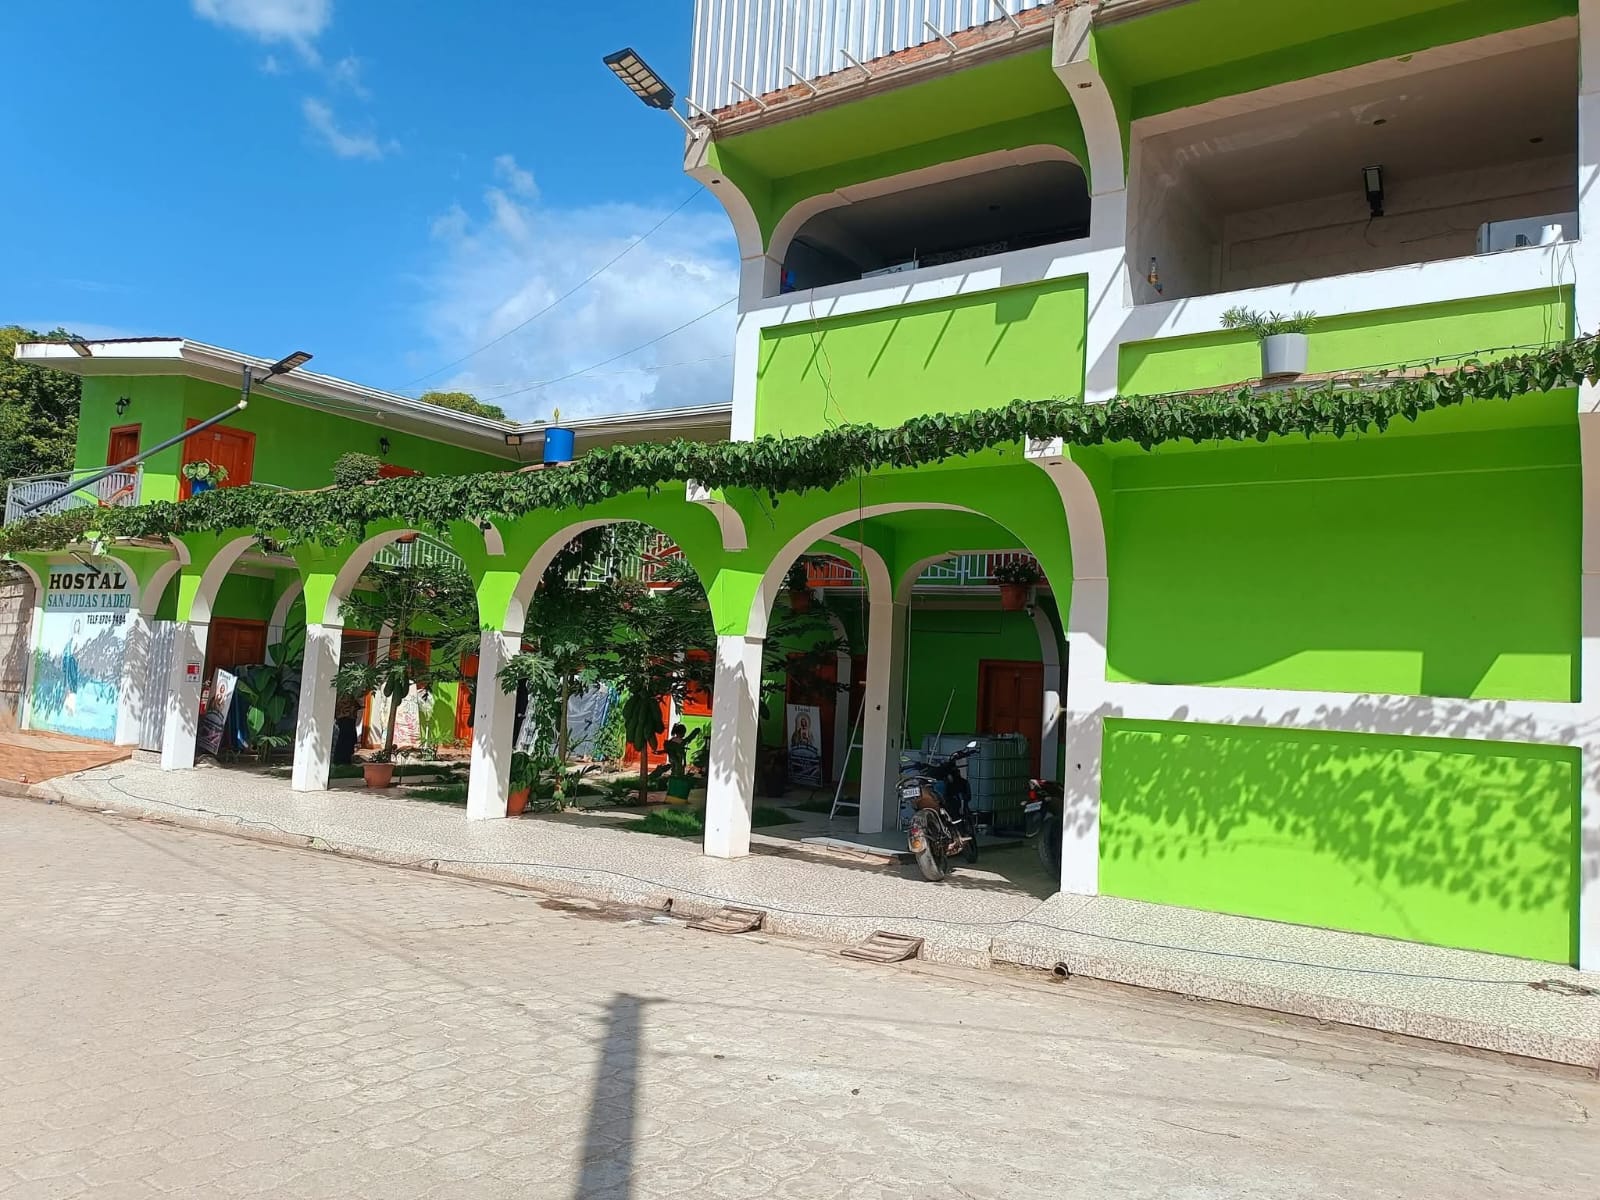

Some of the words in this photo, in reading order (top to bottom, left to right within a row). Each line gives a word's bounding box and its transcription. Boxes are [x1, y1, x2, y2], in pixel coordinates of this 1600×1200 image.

[49, 572, 127, 589] HOSTAL
[48, 594, 65, 607] SAN
[66, 594, 98, 607] JUDAS
[101, 594, 131, 608] TADEO
